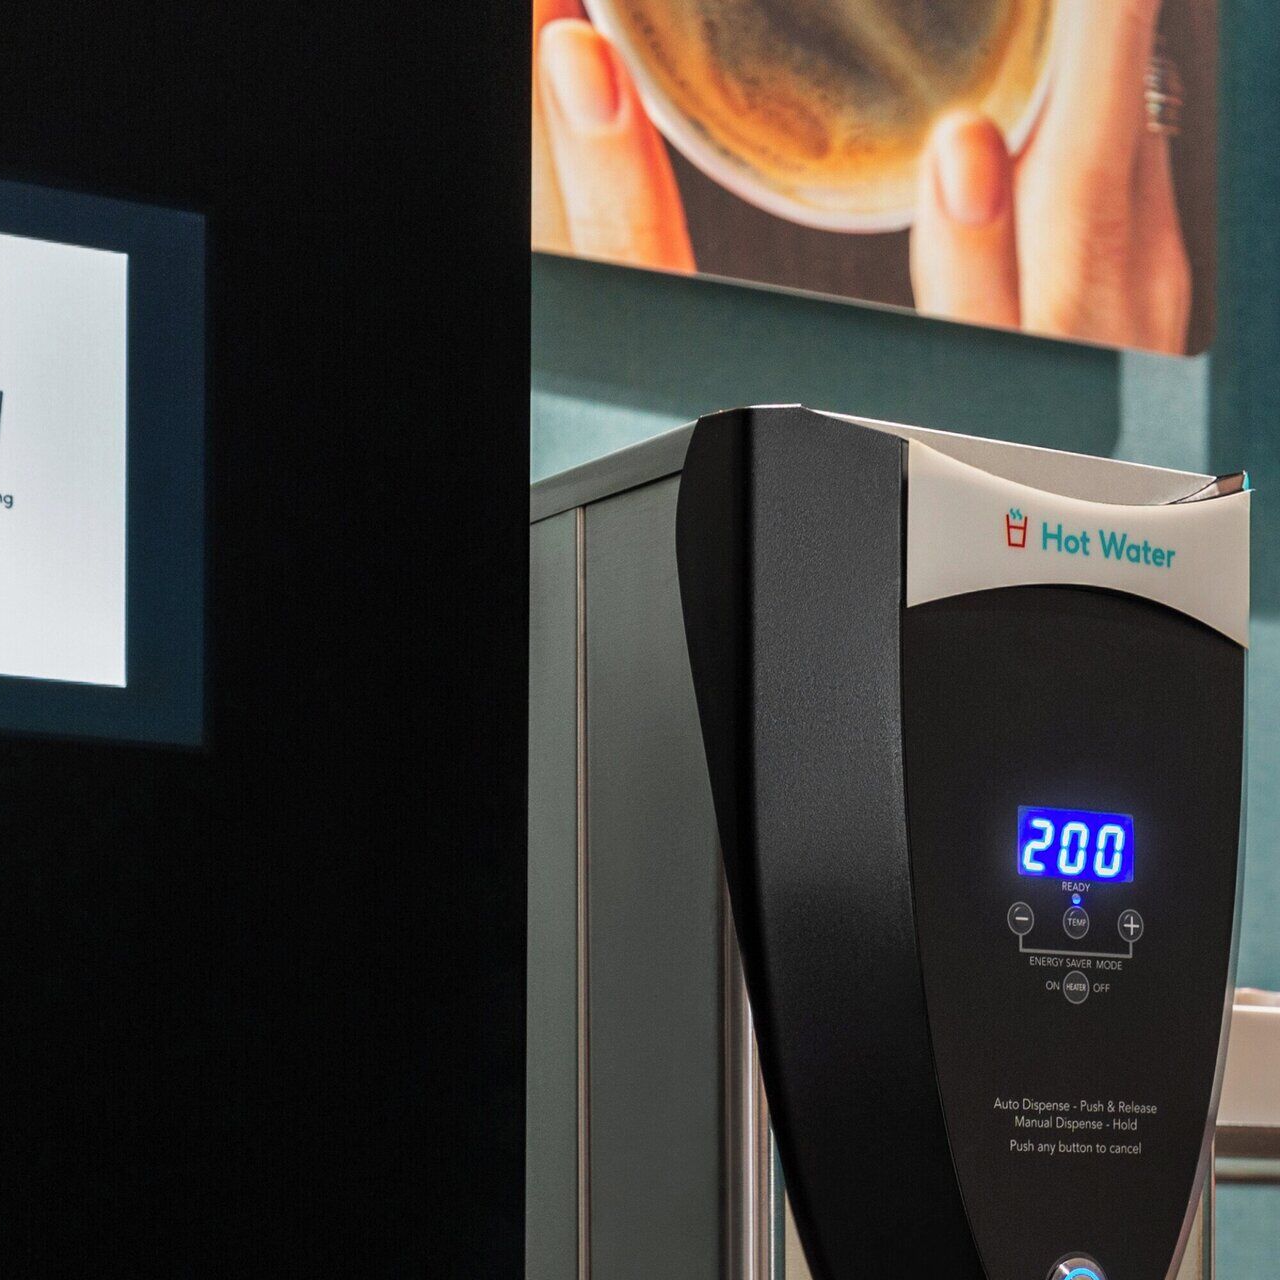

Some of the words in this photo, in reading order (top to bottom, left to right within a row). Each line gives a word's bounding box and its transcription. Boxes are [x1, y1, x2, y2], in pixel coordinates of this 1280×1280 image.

[1042, 522, 1090, 556] Hot
[1098, 529, 1176, 568] Water
[1021, 816, 1126, 878] 200
[1061, 881, 1091, 893] READY
[1067, 917, 1087, 927] TEMP
[1029, 956, 1064, 967] ENERGY
[1066, 958, 1092, 969] SAVER
[1096, 960, 1123, 971] MODE
[1045, 980, 1060, 991] ON
[1066, 982, 1087, 992] HEATER
[1093, 983, 1111, 993] OFF
[993, 1097, 1020, 1110] Auto
[1022, 1098, 1070, 1115] Dispense
[1080, 1100, 1104, 1112] Push
[1107, 1101, 1115, 1113] &
[1118, 1101, 1158, 1114] Release
[1014, 1115, 1053, 1128] Manual
[1055, 1116, 1103, 1132] Dispense
[1112, 1118, 1138, 1131] Hold
[1010, 1139, 1034, 1152] Push
[1037, 1142, 1056, 1156] any
[1058, 1140, 1093, 1153] button
[1096, 1143, 1107, 1154] to
[1109, 1142, 1142, 1155] cancel
